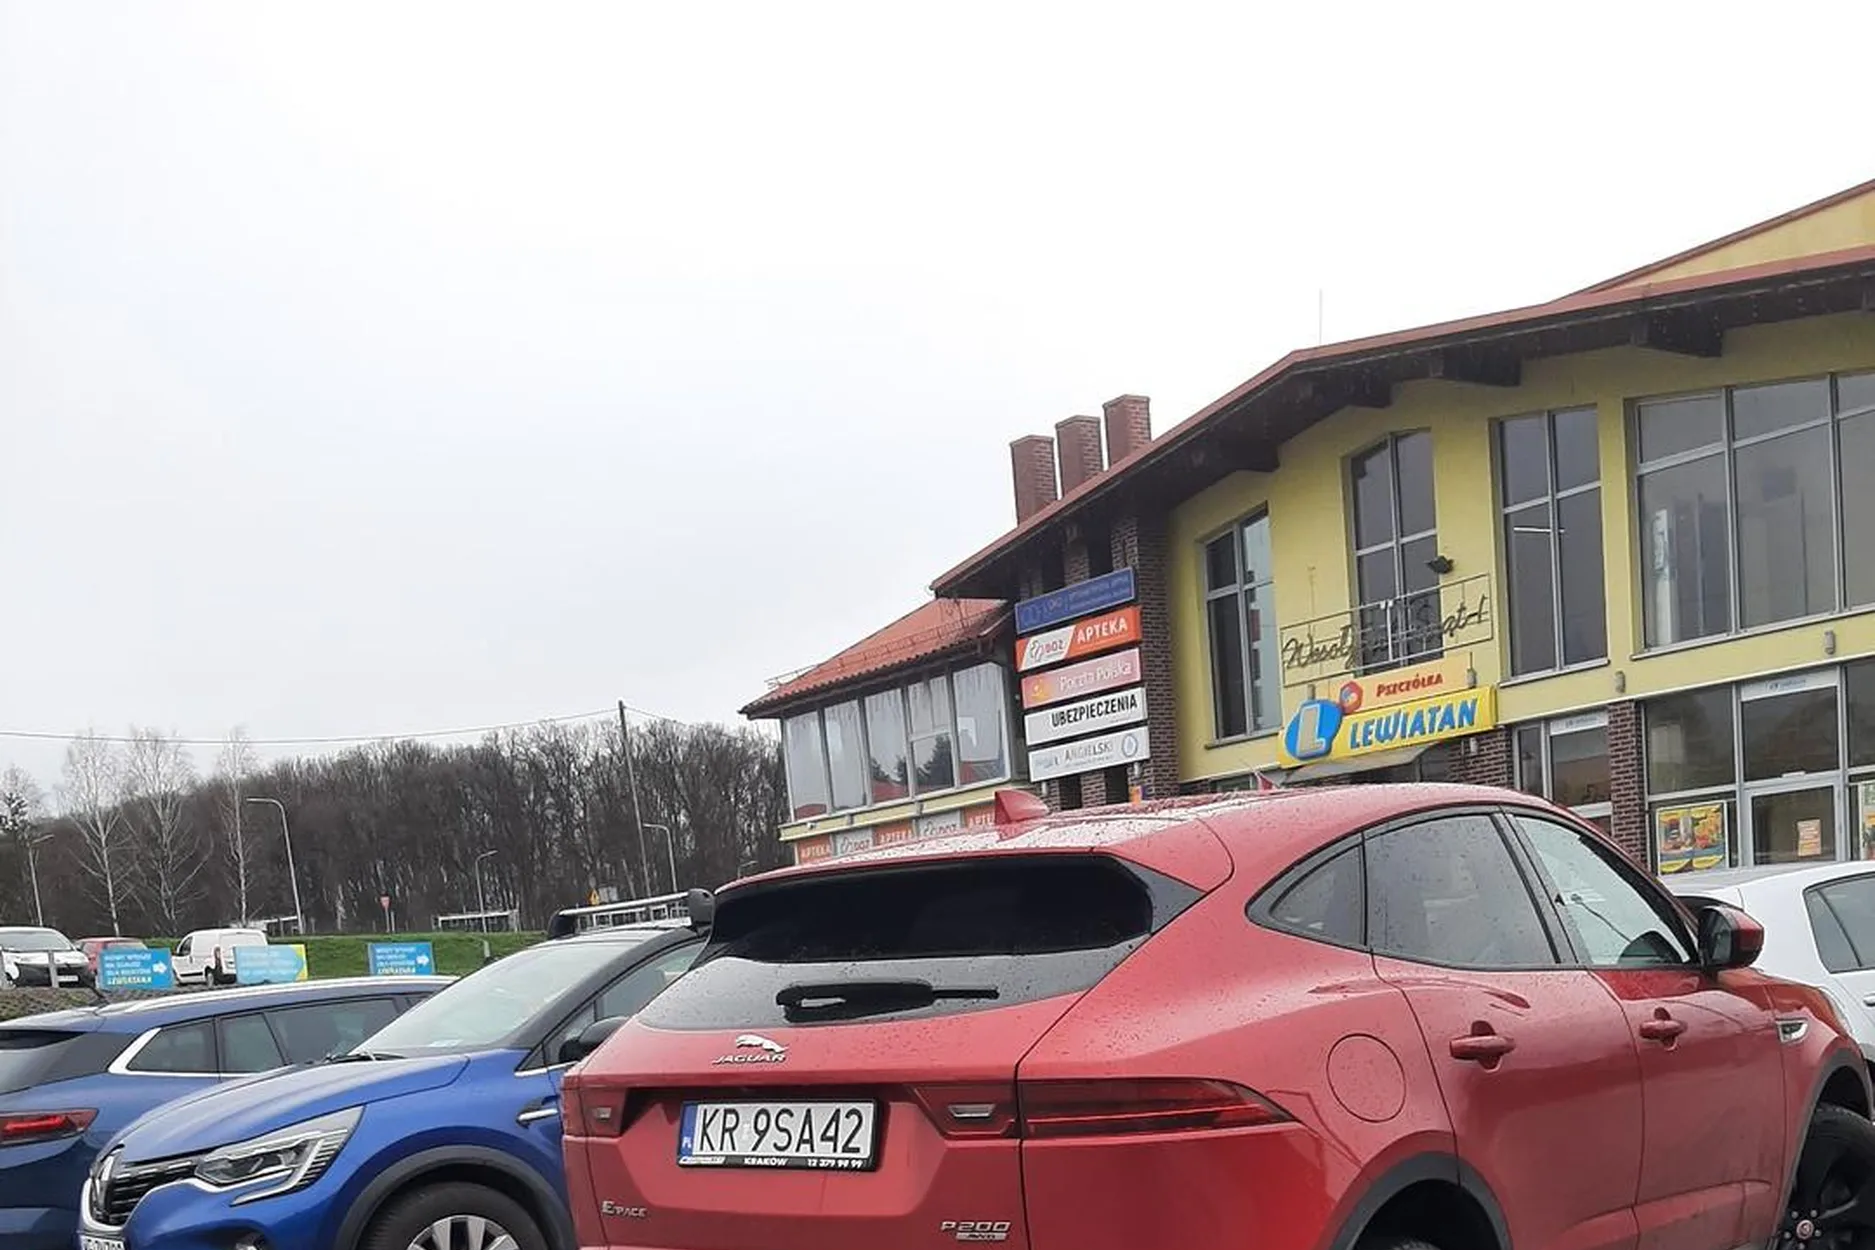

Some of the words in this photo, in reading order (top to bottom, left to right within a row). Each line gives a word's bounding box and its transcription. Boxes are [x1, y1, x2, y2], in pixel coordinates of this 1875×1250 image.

[1076, 617, 1128, 644] APTEKA
[1060, 671, 1094, 692] Poczta
[1051, 694, 1138, 728] UBEZPIECZENIA
[1350, 697, 1478, 750] LEWIATAN
[712, 1054, 786, 1065] JAGUAR
[700, 1108, 740, 1152] KR
[752, 1107, 864, 1154] 9SA42
[941, 1221, 1011, 1232] P200
